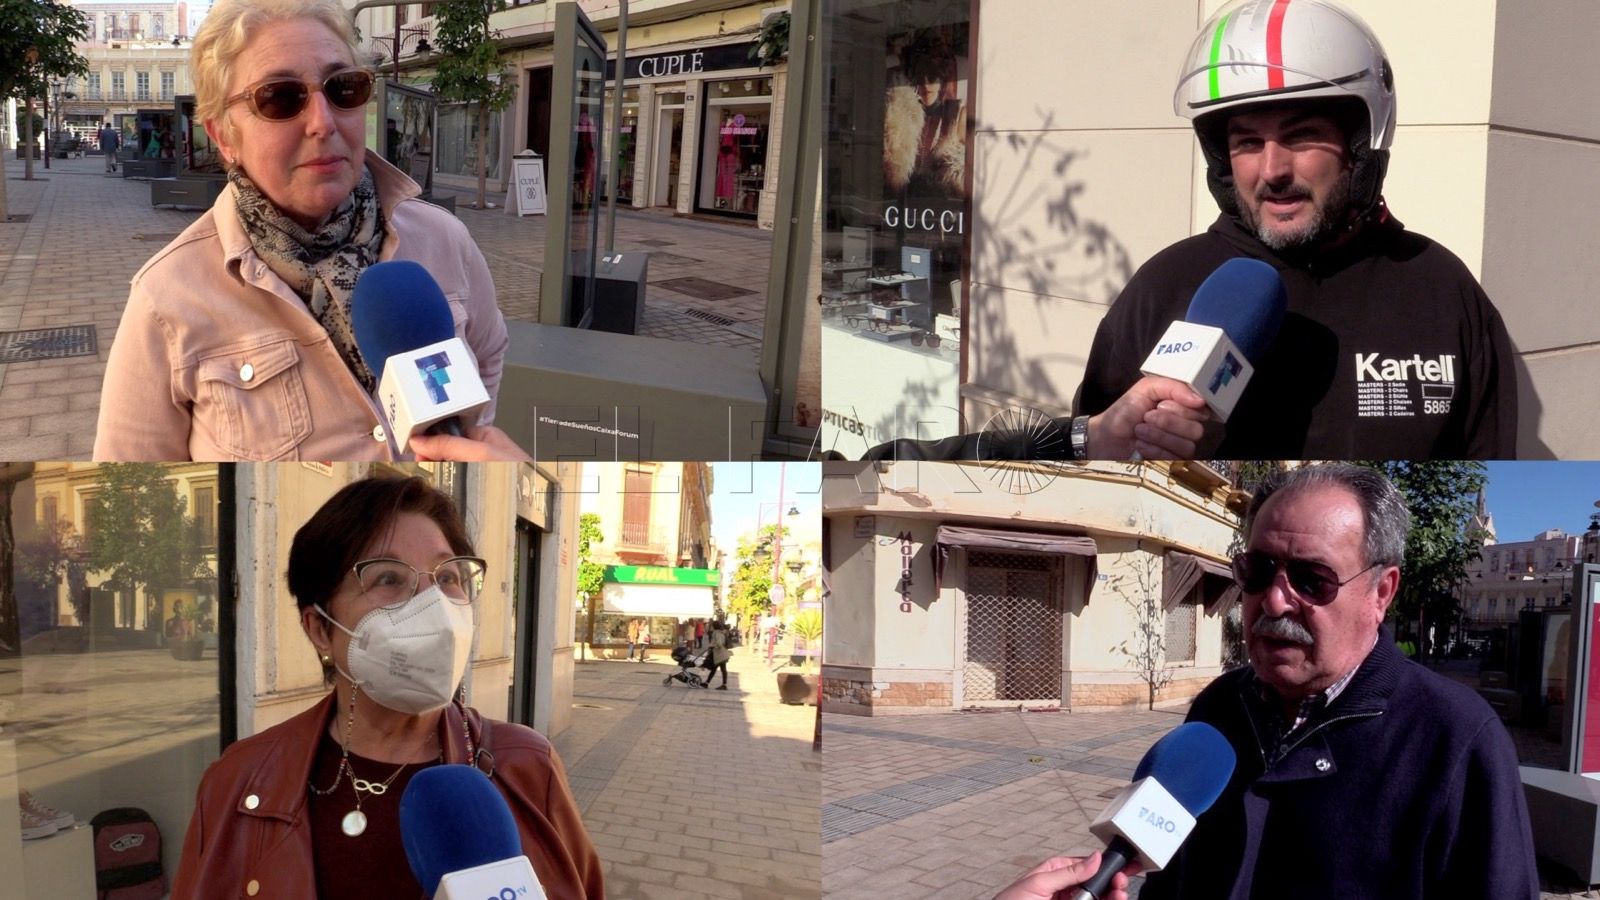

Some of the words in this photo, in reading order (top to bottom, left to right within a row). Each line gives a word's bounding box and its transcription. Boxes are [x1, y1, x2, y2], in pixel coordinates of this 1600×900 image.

[638, 49, 704, 78] CUPLÉ
[885, 206, 963, 234] GUCCI
[1156, 341, 1193, 355] FARO
[1355, 353, 1454, 382] Kartell
[1424, 400, 1451, 414] 5865
[634, 567, 678, 582] RUAL
[1139, 806, 1176, 833] FARO
